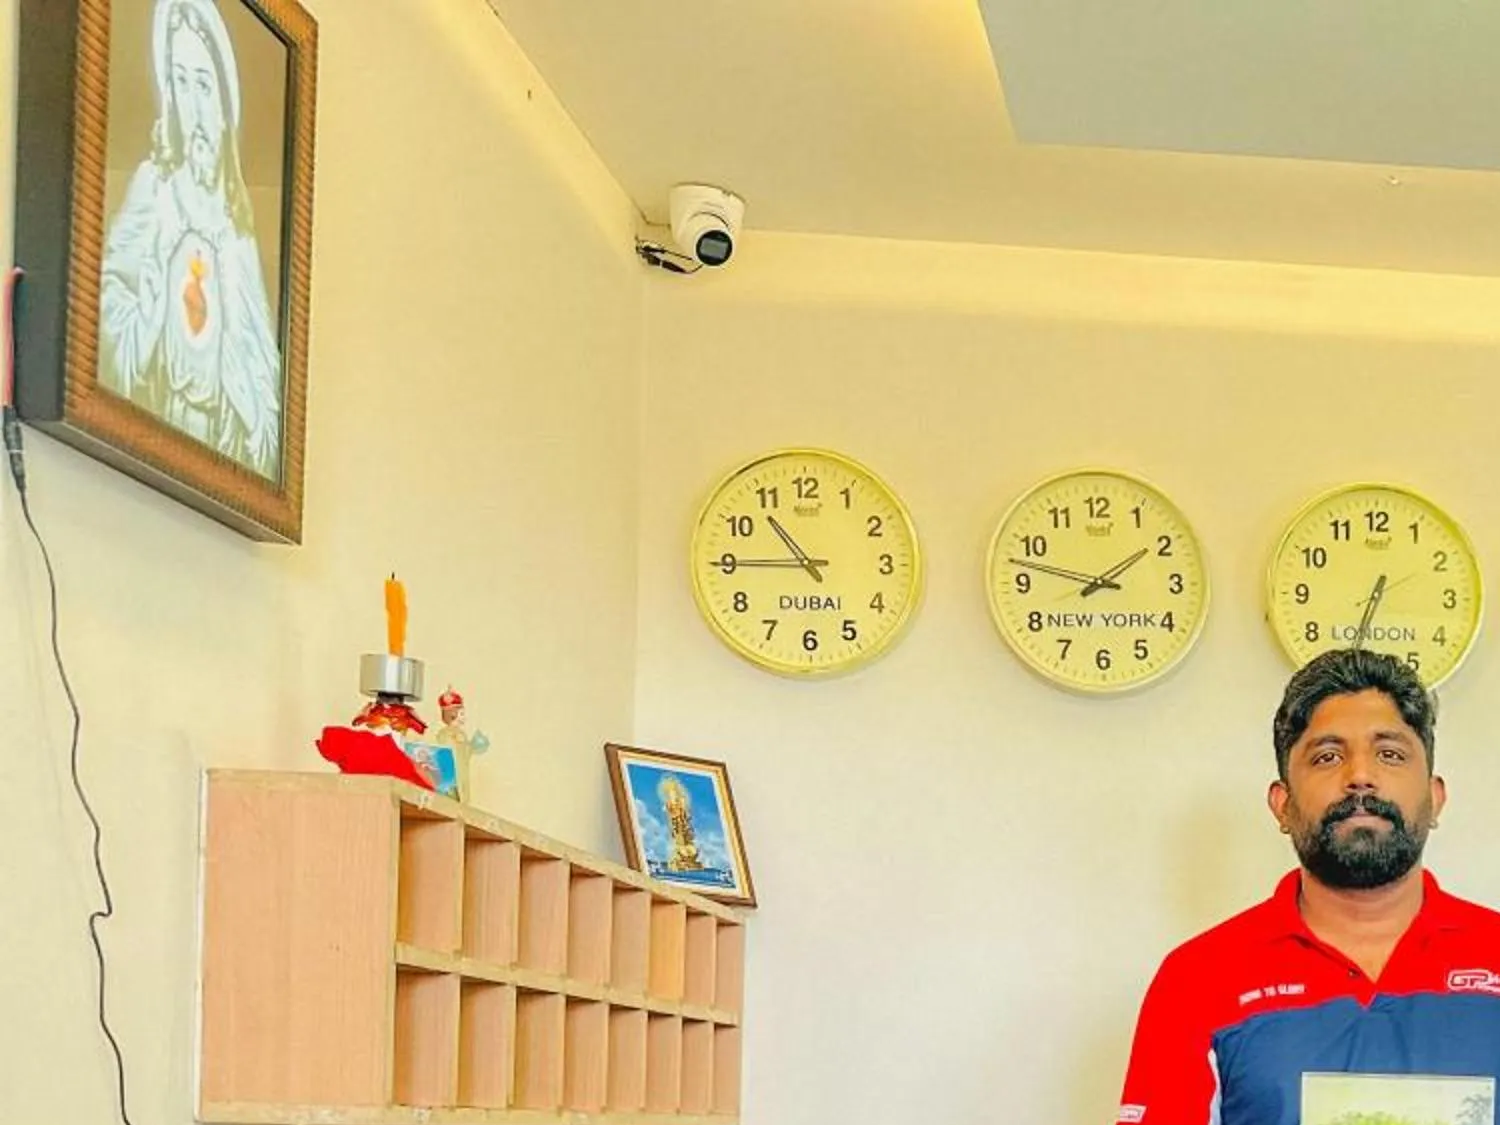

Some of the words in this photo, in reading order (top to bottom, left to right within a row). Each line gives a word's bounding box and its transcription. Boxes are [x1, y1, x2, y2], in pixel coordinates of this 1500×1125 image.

[756, 487, 778, 508] 11
[792, 477, 819, 499] 12
[840, 488, 850, 509] 1
[1084, 497, 1110, 518] 12
[727, 516, 753, 536] 10
[868, 516, 882, 537] 2
[1048, 507, 1070, 528] 11
[1132, 507, 1141, 528] 1
[1365, 511, 1389, 532] 12
[1330, 520, 1350, 541] 11
[1409, 523, 1418, 544] 1
[1021, 536, 1046, 556] 10
[1158, 535, 1172, 556] 2
[721, 554, 736, 574] 9
[879, 554, 893, 575] 3
[1302, 547, 1326, 568] 10
[1433, 551, 1448, 572] 2
[1016, 573, 1030, 594] 9
[1169, 574, 1183, 594] 3
[734, 592, 748, 612] 8
[779, 596, 841, 610] DUBAI
[870, 592, 885, 613] 4
[1295, 584, 1309, 604] 9
[1443, 589, 1457, 609] 3
[762, 620, 777, 640] 7
[842, 620, 857, 640] 5
[1028, 612, 1043, 632] 8
[1047, 613, 1093, 627] NEW
[1100, 613, 1156, 627] YORK
[1160, 612, 1175, 632] 4
[803, 630, 818, 651] 6
[1305, 622, 1319, 642] 8
[1331, 626, 1416, 641] LONDON
[1432, 626, 1446, 646] 4
[1057, 640, 1072, 660] 7
[1096, 649, 1111, 670] 6
[1134, 640, 1148, 660] 5
[1407, 652, 1419, 672] 5
